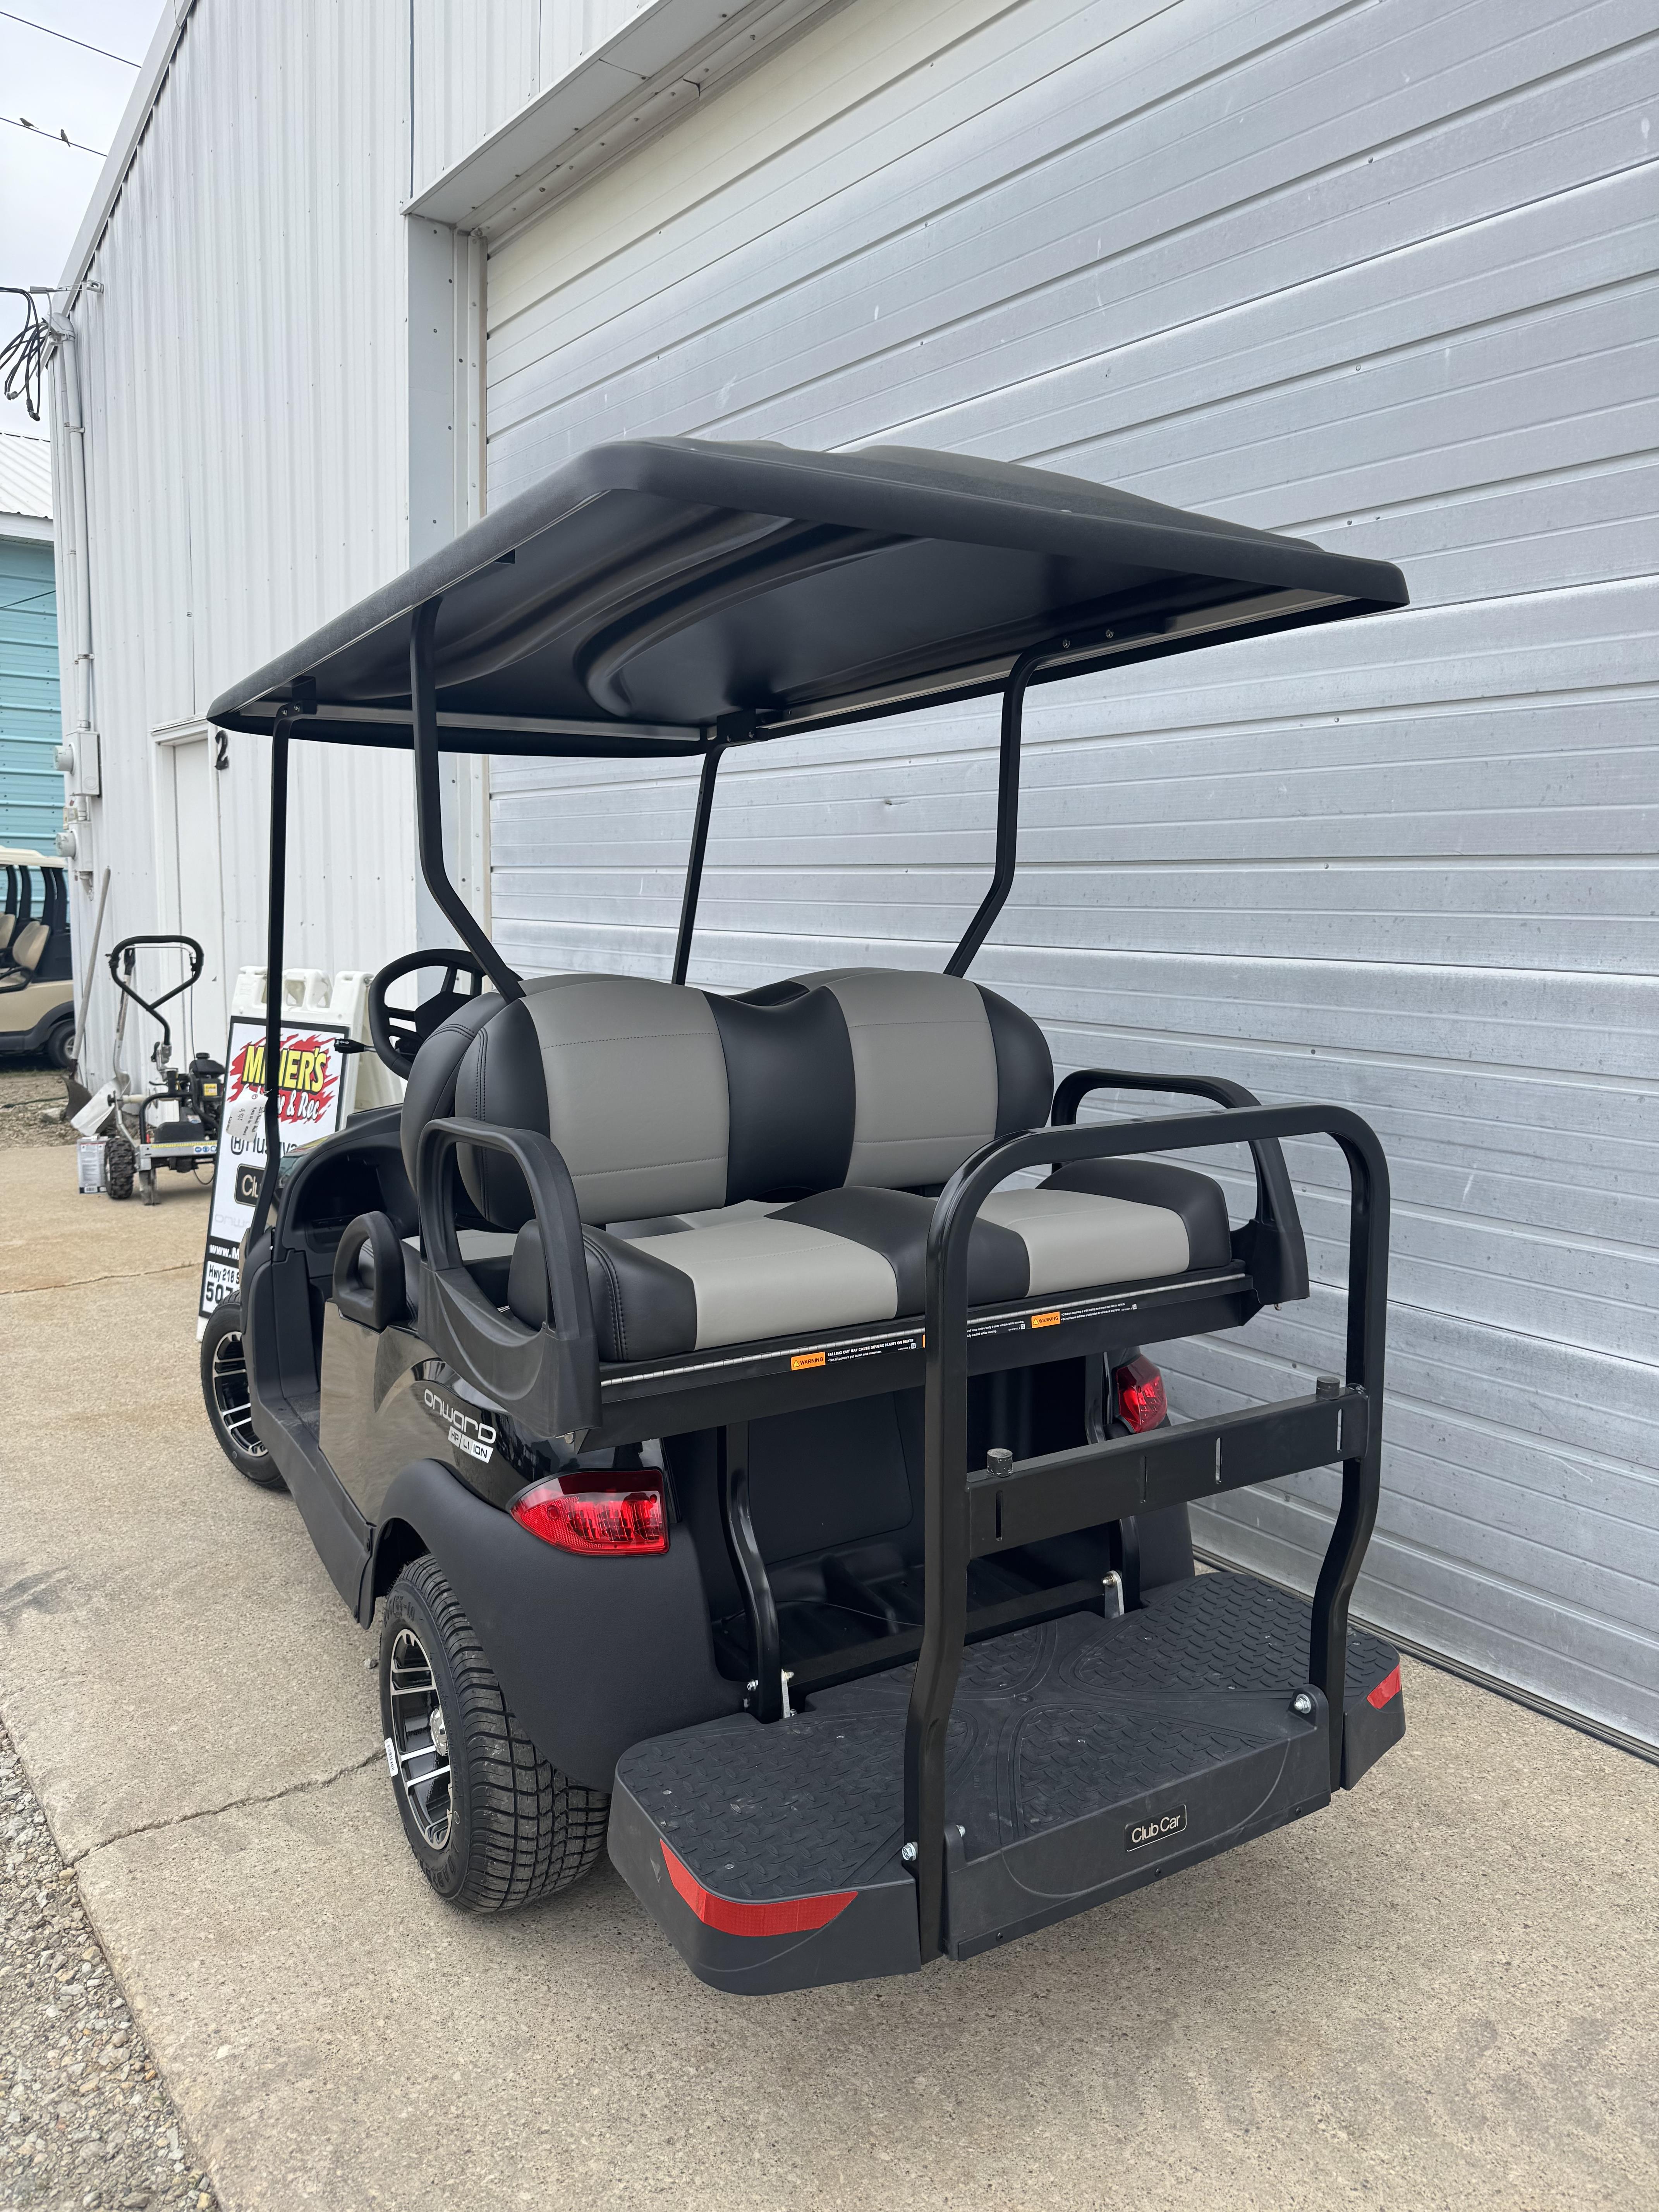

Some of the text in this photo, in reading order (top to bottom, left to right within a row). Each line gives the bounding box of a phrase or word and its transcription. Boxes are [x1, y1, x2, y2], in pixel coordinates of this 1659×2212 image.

[214, 730, 229, 770] 2
[242, 1045, 327, 1093] MER'S
[287, 1090, 297, 1116] &
[297, 1092, 320, 1120] Rec
[242, 1174, 262, 1198] Clu
[209, 1264, 222, 1282] Hwy
[222, 1268, 235, 1284] 218
[1039, 1316, 1058, 1324] WARNING
[800, 1357, 823, 1365] WARNING
[473, 1443, 488, 1459] ION
[1131, 1815, 1181, 1843] Club Car
